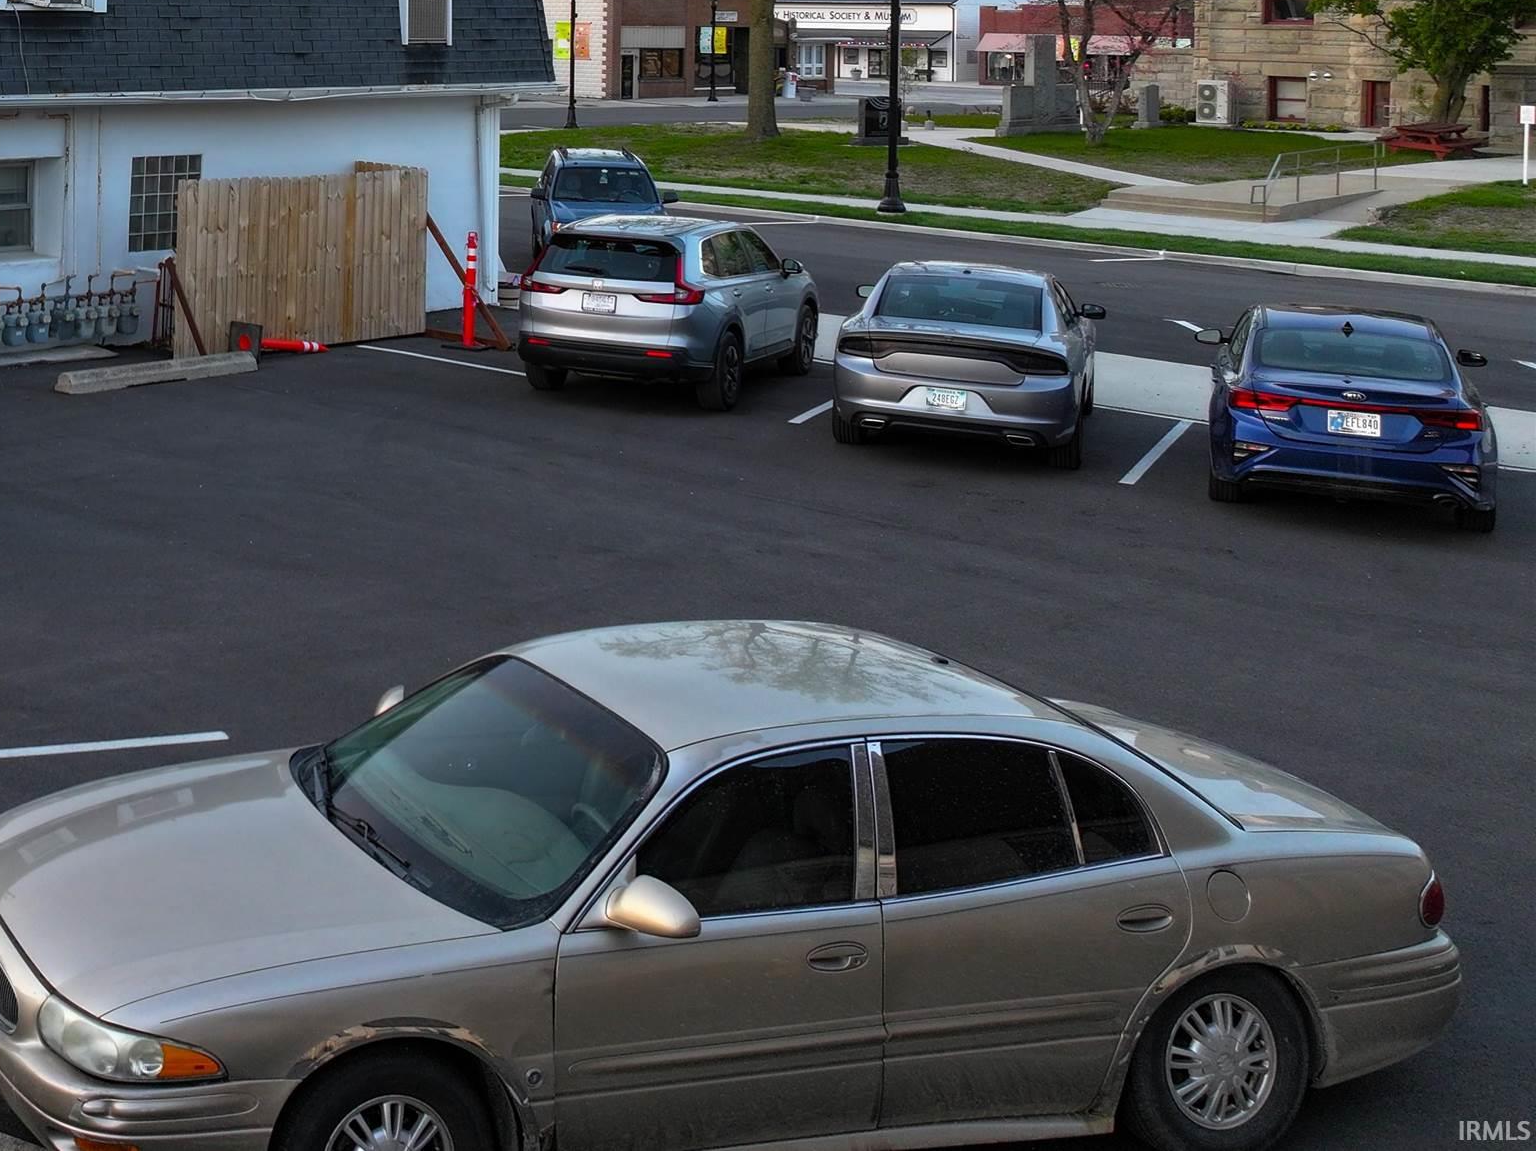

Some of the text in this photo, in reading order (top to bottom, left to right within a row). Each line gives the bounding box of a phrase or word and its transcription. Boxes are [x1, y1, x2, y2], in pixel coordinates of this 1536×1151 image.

[784, 10, 825, 19] HISTORICAL
[829, 10, 861, 20] SOCIETY
[864, 11, 870, 20] &
[1345, 417, 1378, 430] EFL840
